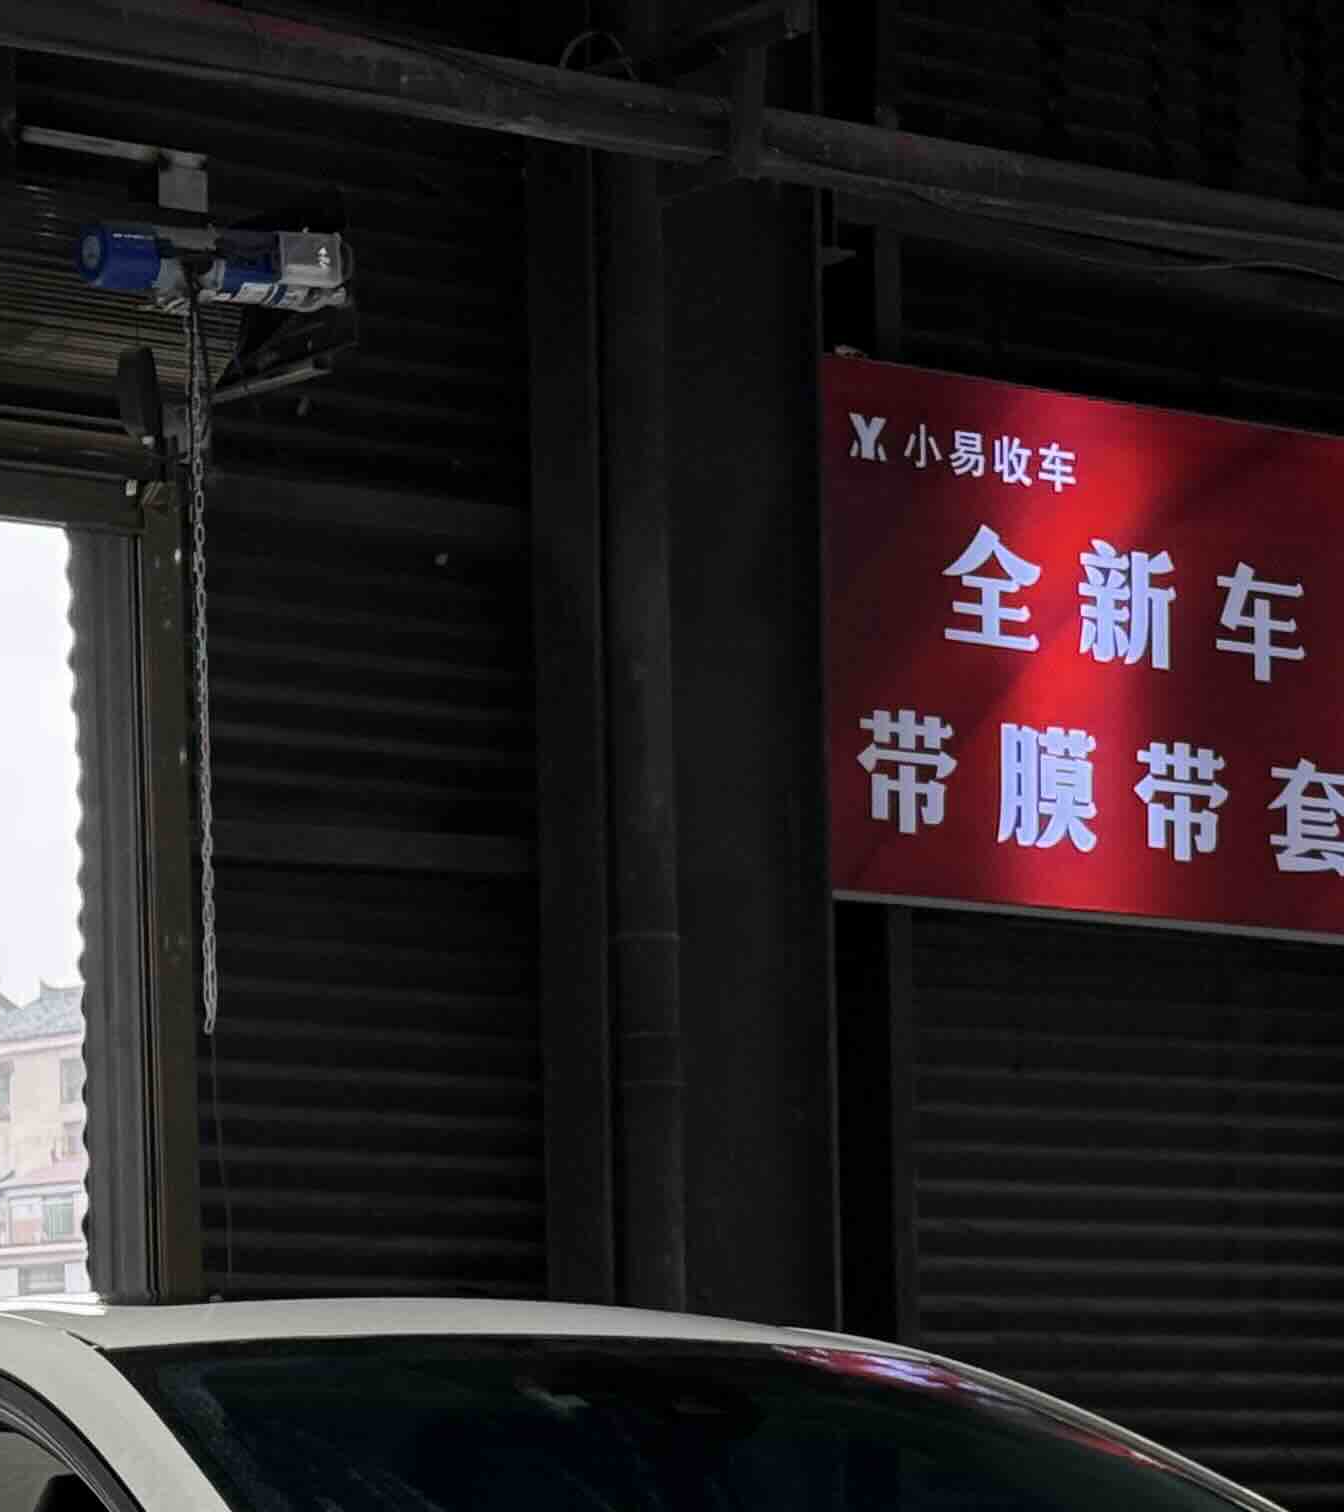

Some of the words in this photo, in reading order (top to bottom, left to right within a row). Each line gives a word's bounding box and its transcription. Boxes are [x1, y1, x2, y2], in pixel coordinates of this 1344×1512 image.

[904, 424, 1076, 493] 小易收车
[942, 523, 1306, 682] 全新车
